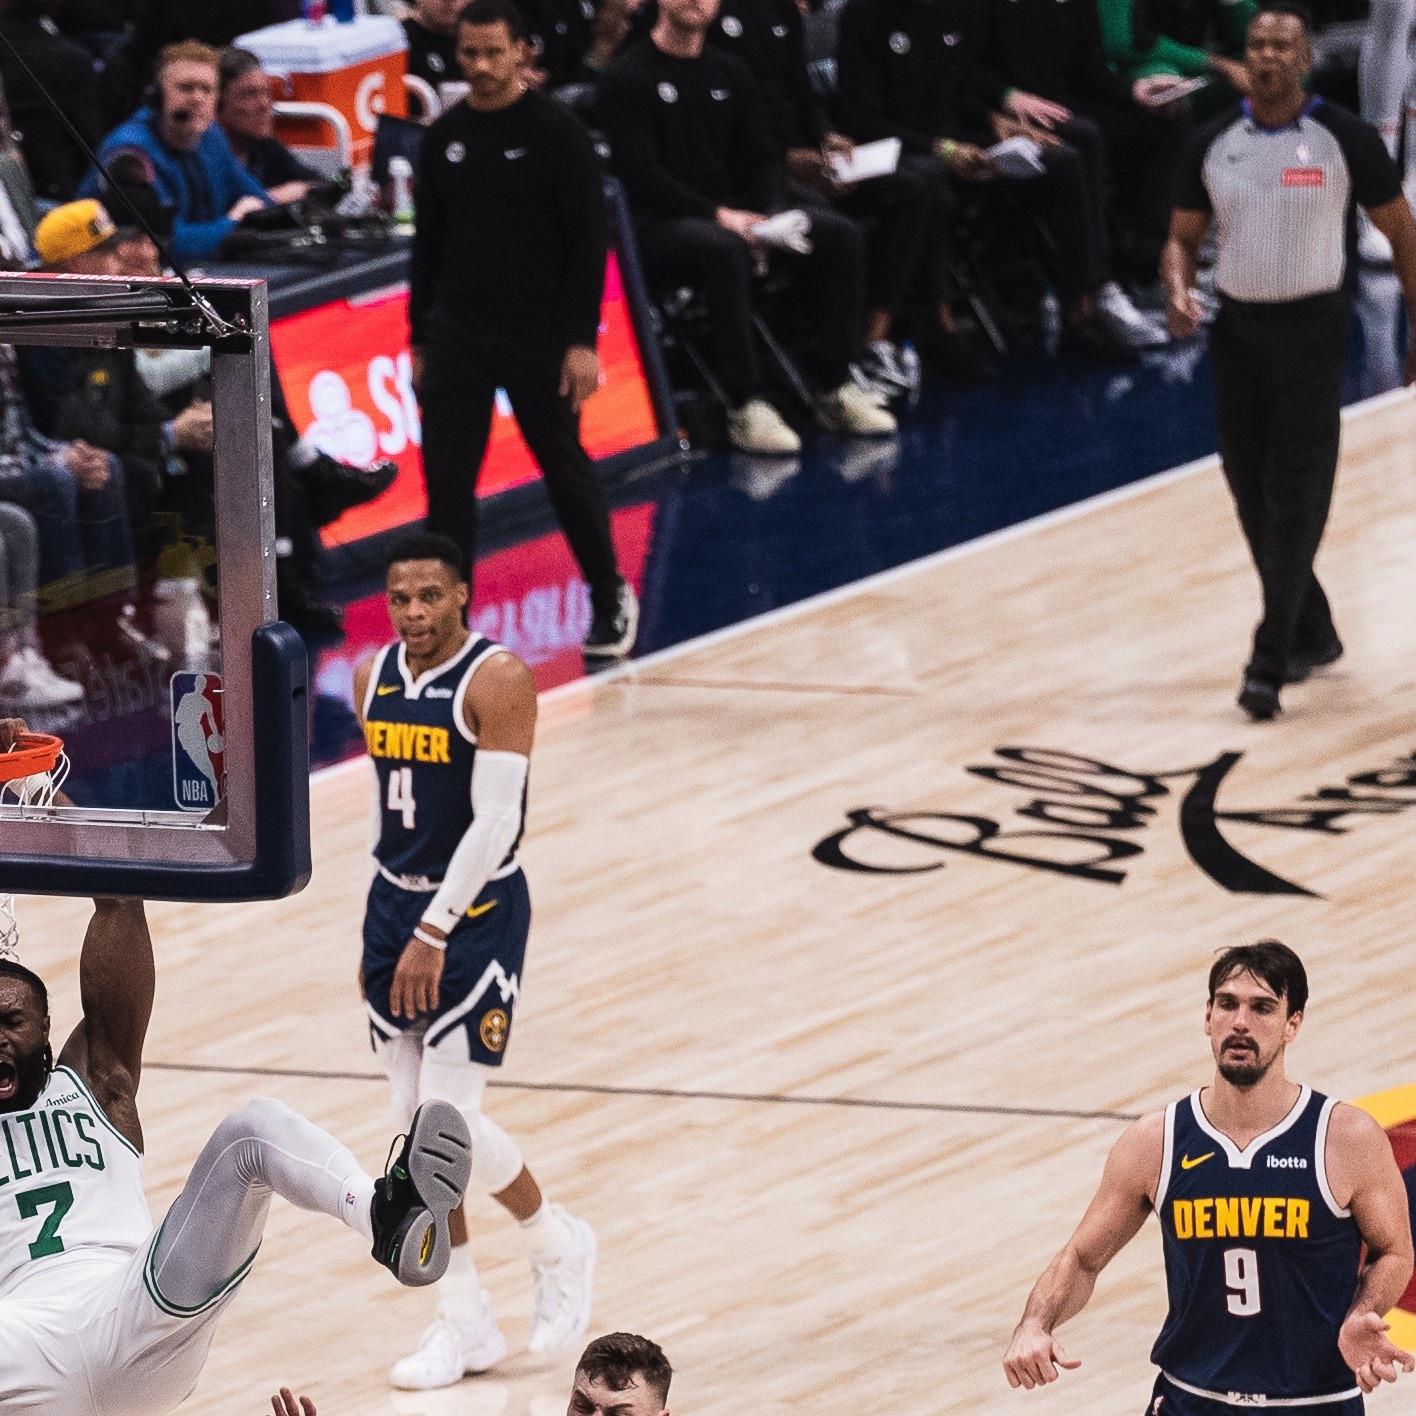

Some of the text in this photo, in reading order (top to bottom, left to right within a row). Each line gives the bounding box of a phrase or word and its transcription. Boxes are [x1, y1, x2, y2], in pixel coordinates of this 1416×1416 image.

[181, 779, 209, 802] NBA
[387, 766, 417, 830] 4
[44, 1091, 80, 1108] Amica
[1266, 1154, 1307, 1169] ibotta
[14, 1180, 75, 1260] 7
[1172, 1197, 1311, 1240] DENVER
[1223, 1247, 1262, 1317] 9
